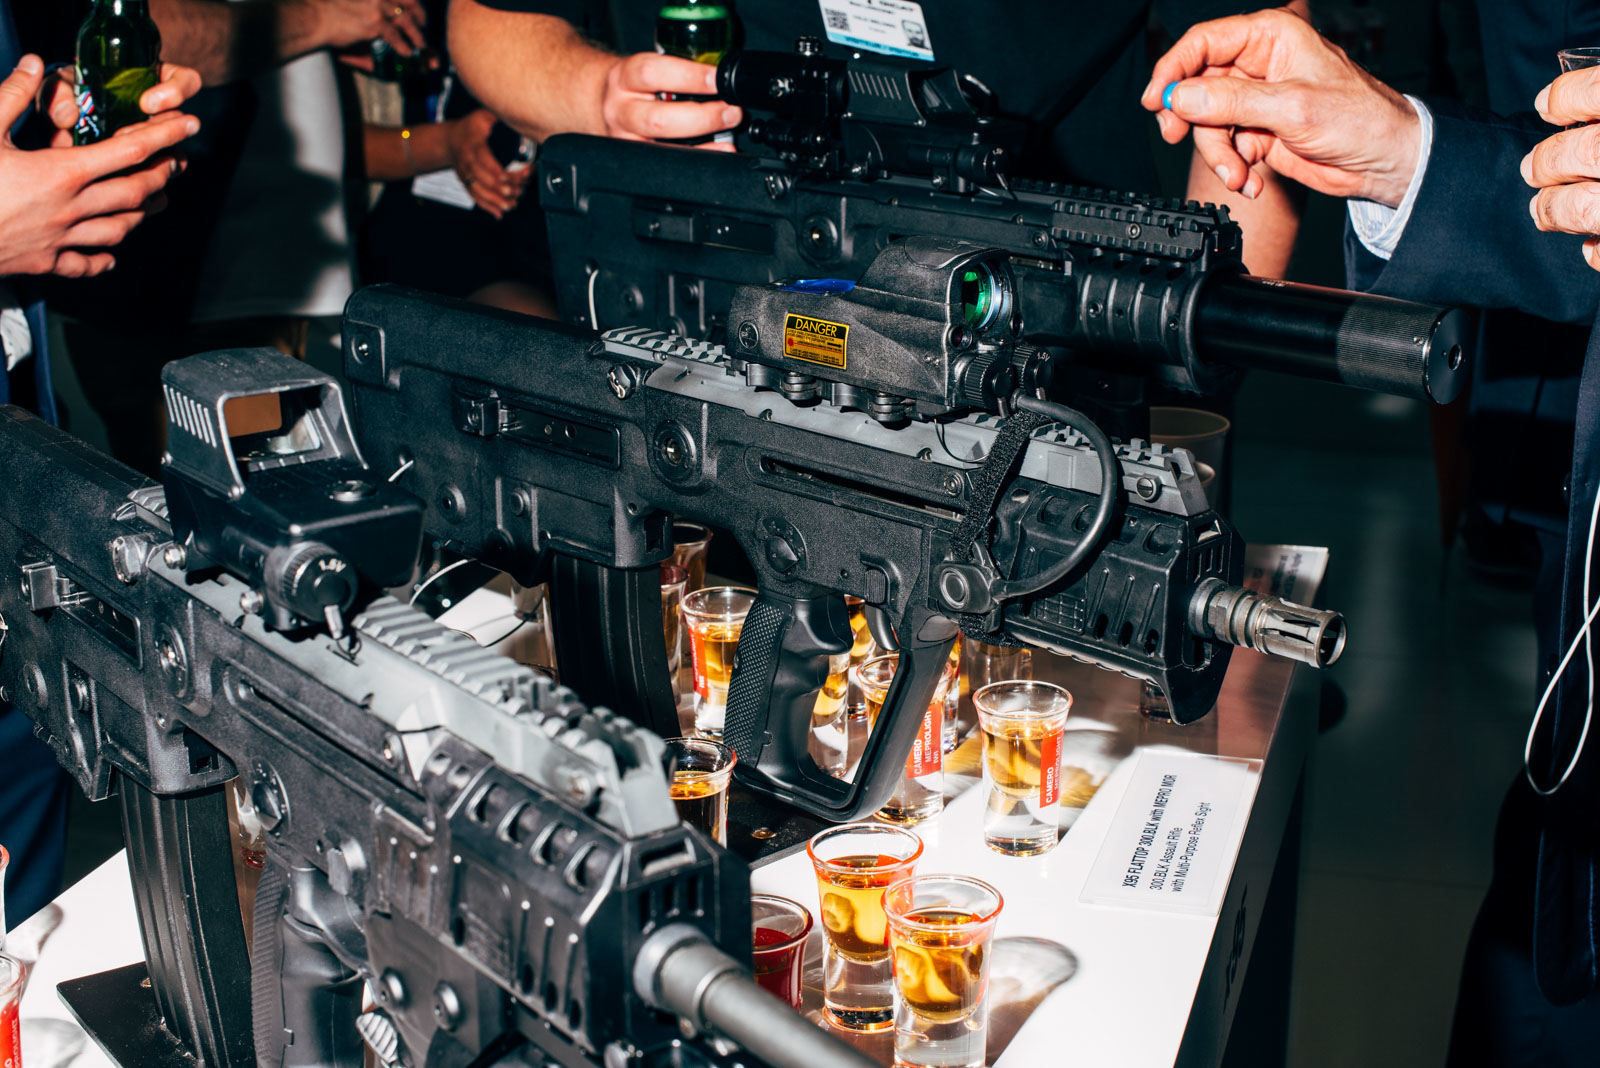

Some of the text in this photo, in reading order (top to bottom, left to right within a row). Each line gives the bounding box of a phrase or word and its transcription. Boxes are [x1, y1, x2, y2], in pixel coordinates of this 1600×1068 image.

[795, 318, 837, 338] DANGER
[913, 738, 923, 775] CAMERO
[1046, 767, 1054, 804] CAMERO
[1122, 774, 1177, 888] X95 FLATTOP 300.BLK with MEPRO MOR
[1171, 802, 1211, 892] with Multi-Purpose Reflex Sight
[1150, 828, 1183, 890] 300.BLK Assault Rifle
